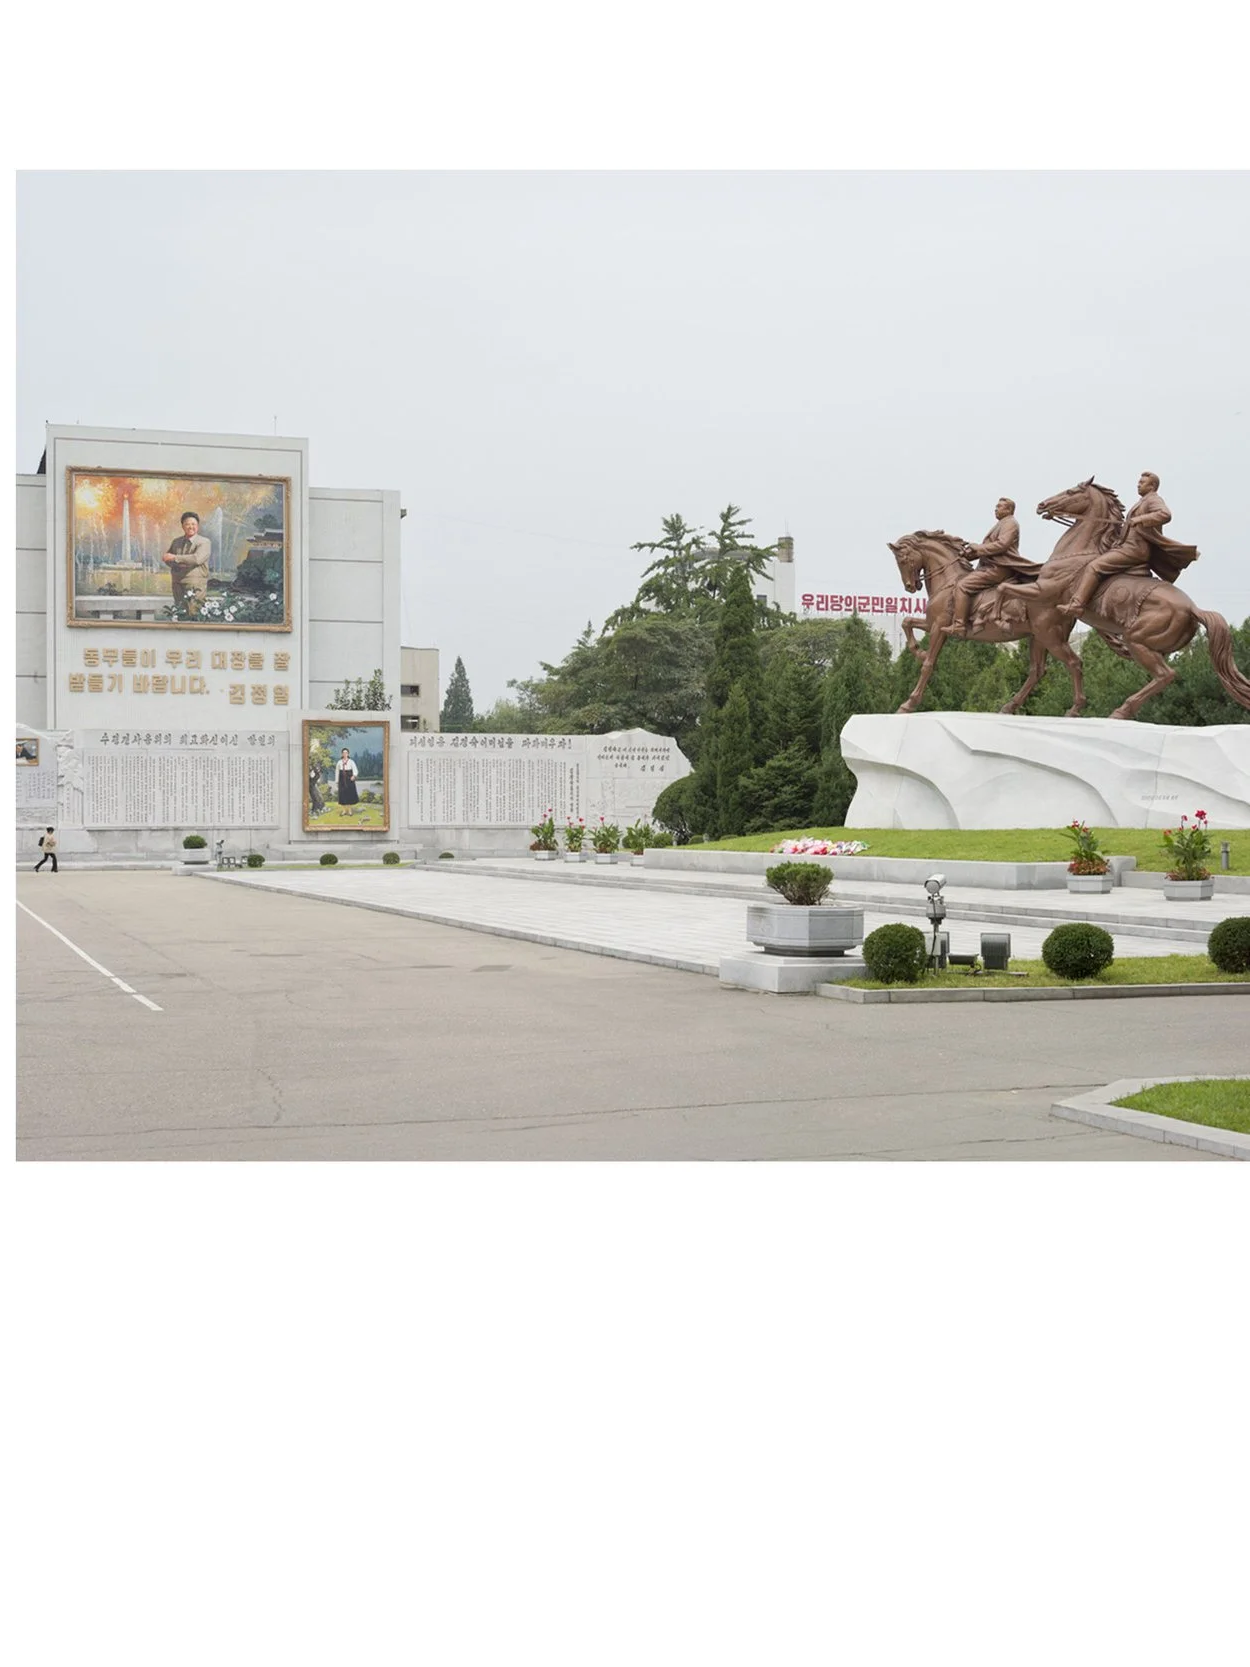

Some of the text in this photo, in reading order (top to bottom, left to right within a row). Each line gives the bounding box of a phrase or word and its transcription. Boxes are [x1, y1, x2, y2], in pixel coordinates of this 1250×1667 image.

[83, 647, 291, 672] 동무들이 우리 대장을 잘
[68, 672, 211, 695] 받들기 바랍니다.
